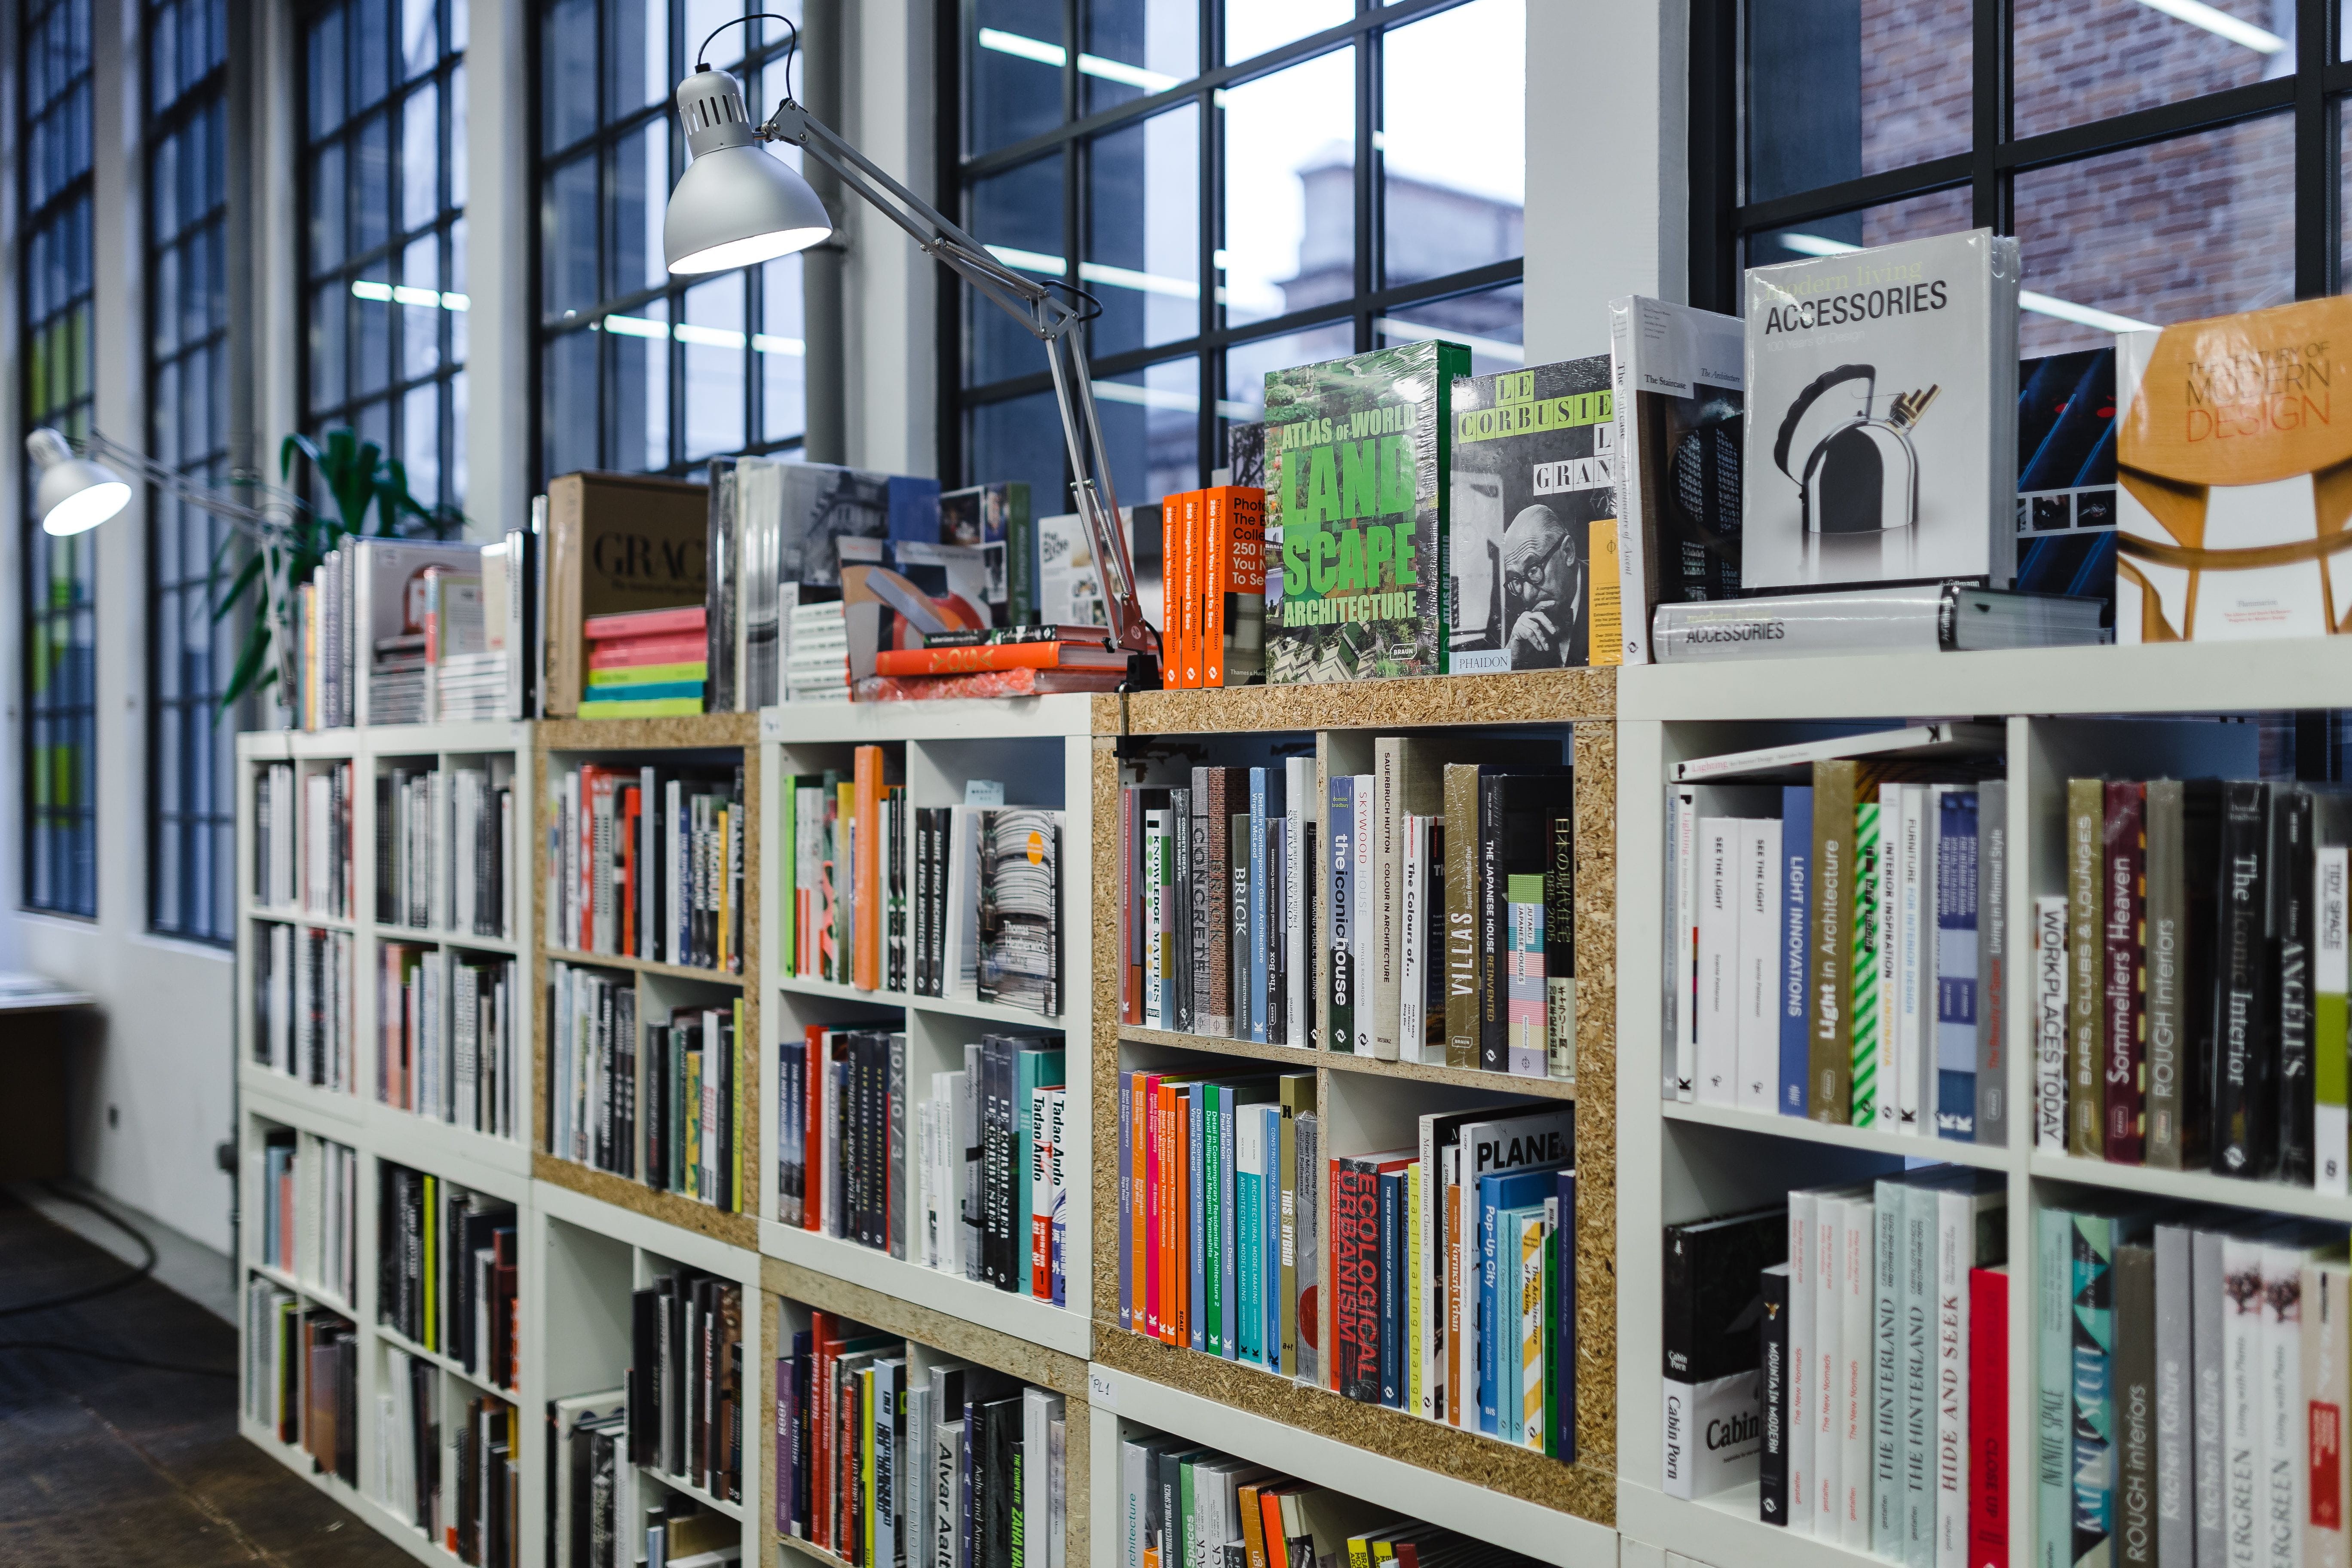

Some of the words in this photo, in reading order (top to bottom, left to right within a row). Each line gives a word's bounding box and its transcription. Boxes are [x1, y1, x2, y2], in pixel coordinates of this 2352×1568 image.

[1857, 261, 1923, 287] living
[1765, 280, 1948, 335] ACCESSORIES
[1500, 374, 1531, 400] LE
[1645, 374, 1658, 384] The
[1660, 376, 1687, 390] Staircase
[1283, 422, 1331, 450] ATLAS
[1336, 426, 1349, 441] OF
[1351, 403, 1416, 438] WORLD
[1462, 393, 1612, 436] CORBUSIE
[2187, 393, 2331, 443] DESIGN
[1283, 434, 1416, 526] LAND
[1234, 512, 1256, 526] The
[1233, 542, 1256, 555] 250
[1233, 557, 1256, 570] You
[1283, 521, 1417, 596] SCAPE
[1283, 590, 1417, 628] ARCHITECTURE
[1685, 622, 1785, 643] ACCESSORIES
[1393, 647, 1414, 656] BRAUN
[1459, 656, 1508, 670] PHAIDON
[1359, 792, 1368, 864] SKYWOOD
[1486, 841, 1494, 863] THE
[1485, 866, 1494, 916] JAPANESE
[1554, 817, 1571, 943] 日本の現代住宅
[1789, 856, 1804, 904] LIGHT
[1885, 842, 1895, 897] INTERIOR
[2077, 815, 2092, 918] LOUNGES
[2232, 854, 2258, 900] The
[1193, 828, 1205, 972] CONCRETE
[1210, 860, 1222, 946] BRICK
[1234, 867, 1246, 936] BRICK
[1359, 870, 1368, 916] HOUSE
[1384, 903, 1390, 911] IN
[1406, 891, 1415, 944] Colours
[1547, 869, 1556, 941] 1985-2005
[1820, 839, 1840, 956] Architecture
[2108, 858, 2131, 940] Heaven
[1451, 913, 1473, 995] VILLAS
[1486, 919, 1494, 952] HOUSE
[1884, 902, 1894, 979] INSPIRATION
[1406, 948, 1414, 977] of...
[1788, 907, 1804, 1018] INNOVATIONS
[1821, 962, 1837, 978] in
[2043, 909, 2060, 1064] WORKPLACES
[2078, 945, 2092, 1015] CLUBS
[2153, 918, 2174, 1005] interiors
[1486, 956, 1495, 1022] REINVENTED
[1819, 984, 1839, 1040] Light
[1883, 982, 1893, 1067] SCANDINAVIA
[2228, 990, 2254, 1086] Interior
[2078, 1022, 2093, 1086] BARS,
[2153, 1011, 2174, 1097] ROUGH
[1033, 1097, 1044, 1139] Tadao
[1053, 1100, 1064, 1144] Tadao
[2043, 1074, 2061, 1138] TODAY
[1033, 1143, 1044, 1182] Ando
[1053, 1147, 1064, 1186] Ando
[1340, 1169, 1357, 1343] URBANISM
[1483, 1206, 1496, 1256] Pop-Up
[1357, 1172, 1377, 1380] ECOLOGICAL
[1410, 1194, 1420, 1327] Facilitating
[1451, 1243, 1461, 1293] Formerly
[1483, 1260, 1496, 1288] City
[1452, 1296, 1461, 1332] Urban
[1942, 1295, 1958, 1360] SEEK
[1093, 1378, 1111, 1396] PL1
[1412, 1335, 1420, 1407] Change
[1767, 1341, 1779, 1405] MOUNTAIN
[1879, 1298, 1895, 1436] HINTERLAND
[1908, 1306, 1924, 1446] HINTERLAND
[1485, 1406, 1495, 1416] BIS
[1668, 1396, 1681, 1442] Cabin
[1942, 1369, 1958, 1419] AND
[1706, 1412, 1759, 1452] Cabin
[1765, 1406, 1778, 1455] MODERN
[2128, 1382, 2148, 1473] interiors
[939, 1442, 953, 1511] Alvar
[1667, 1444, 1681, 1481] Porn
[1878, 1442, 1894, 1483] THE
[1908, 1452, 1923, 1494] THE
[1942, 1430, 1958, 1493] HIDE
[1011, 1507, 1023, 1546] ZAHA
[1128, 1493, 1137, 1568] rchitecture
[1164, 1503, 1172, 1521] PUBLIC
[2125, 1479, 2149, 1563] ROUGH
[938, 1515, 952, 1568] Aalt
[1164, 1528, 1173, 1553] PROJECTS
[1186, 1514, 1195, 1568] Spaces
